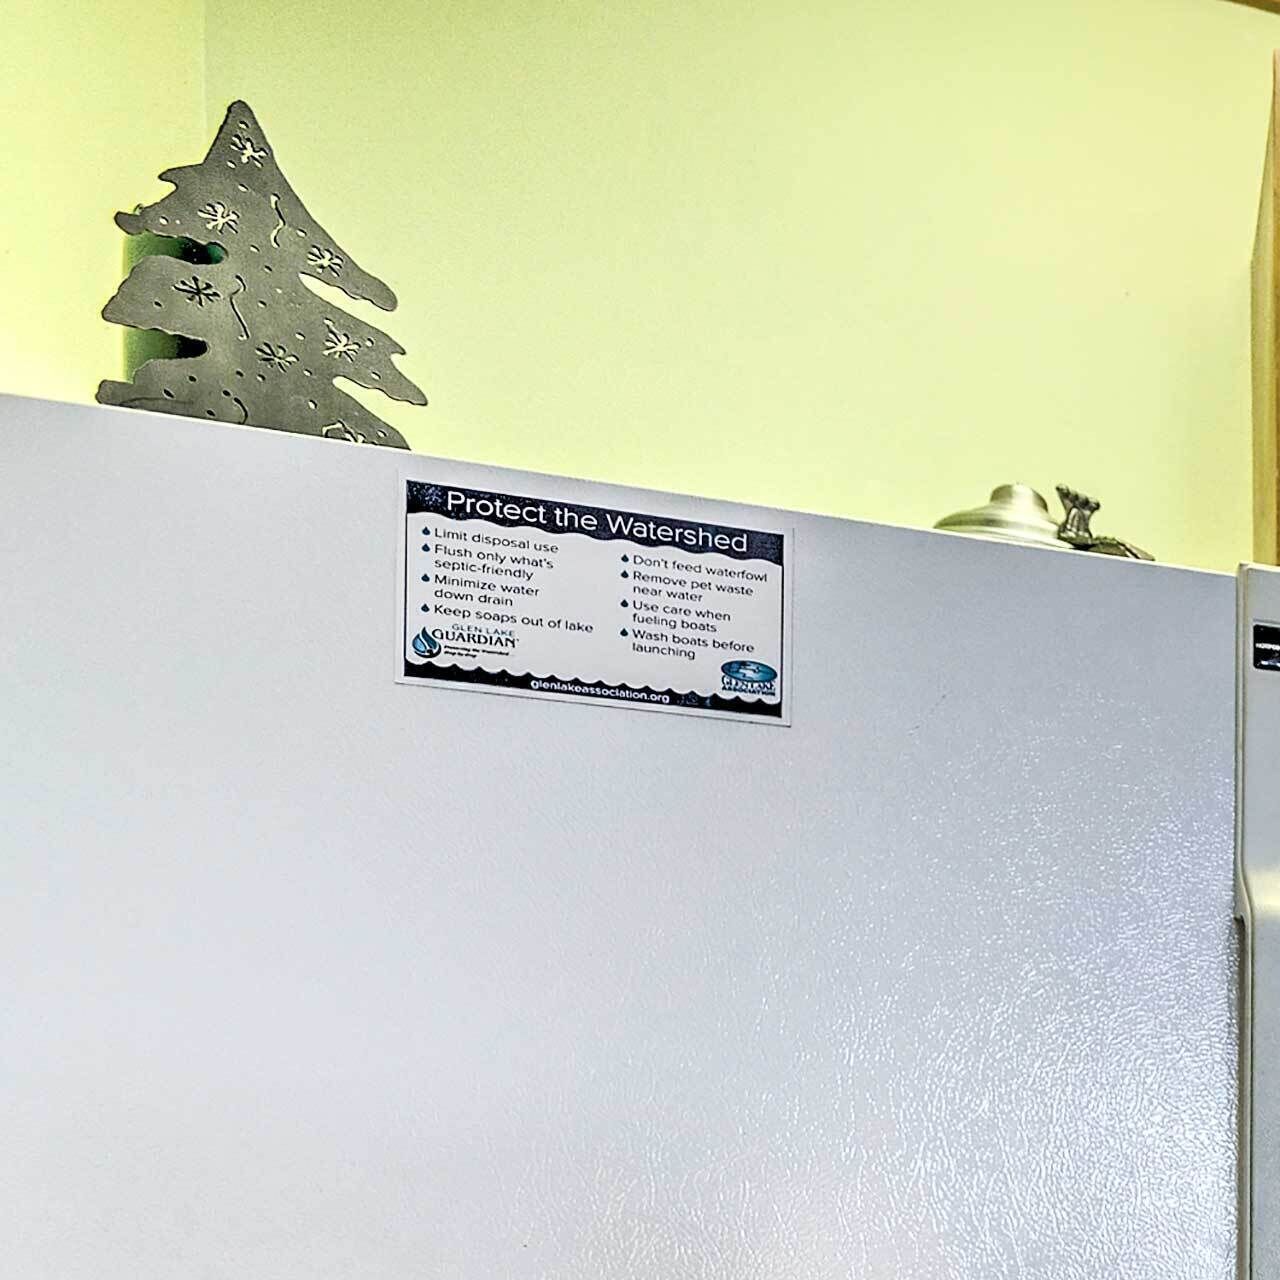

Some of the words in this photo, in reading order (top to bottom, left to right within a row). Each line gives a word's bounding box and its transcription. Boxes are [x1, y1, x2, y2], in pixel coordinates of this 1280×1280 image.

[447, 491, 547, 524] Protect
[554, 507, 598, 531] the
[606, 513, 748, 552] Watershed
[434, 527, 467, 542] Limit
[471, 532, 530, 549] disposal
[534, 543, 559, 554] use
[434, 543, 473, 558] Flush
[476, 551, 506, 564] only
[510, 556, 554, 570] what's
[434, 559, 534, 581] septic-friendly
[633, 554, 668, 569] Don't
[672, 560, 702, 573] feed
[705, 567, 768, 583] waterfowl
[434, 574, 496, 591] Minimize
[500, 584, 540, 597] water
[633, 571, 687, 587] Remove
[690, 579, 712, 591] pet
[716, 582, 754, 596] waste
[633, 585, 663, 597] near
[667, 590, 703, 602] water
[434, 589, 473, 602] down
[478, 593, 513, 607] drain
[434, 604, 471, 619] Keep
[475, 610, 517, 625] soaps
[521, 615, 544, 627] out
[547, 619, 562, 629] of
[565, 620, 594, 633] lake
[632, 600, 659, 612] Use
[663, 605, 692, 617] care
[695, 609, 731, 622] when
[452, 623, 482, 633] GLEN
[486, 627, 514, 637] LAKE
[632, 613, 677, 630] fueling
[681, 619, 717, 633] boats
[431, 628, 516, 649] GUARDIAN
[632, 629, 668, 643] Wash
[672, 634, 709, 648] boats
[712, 639, 755, 653] before
[632, 642, 696, 660] launching
[530, 680, 670, 704] glenlakeassociation.org
